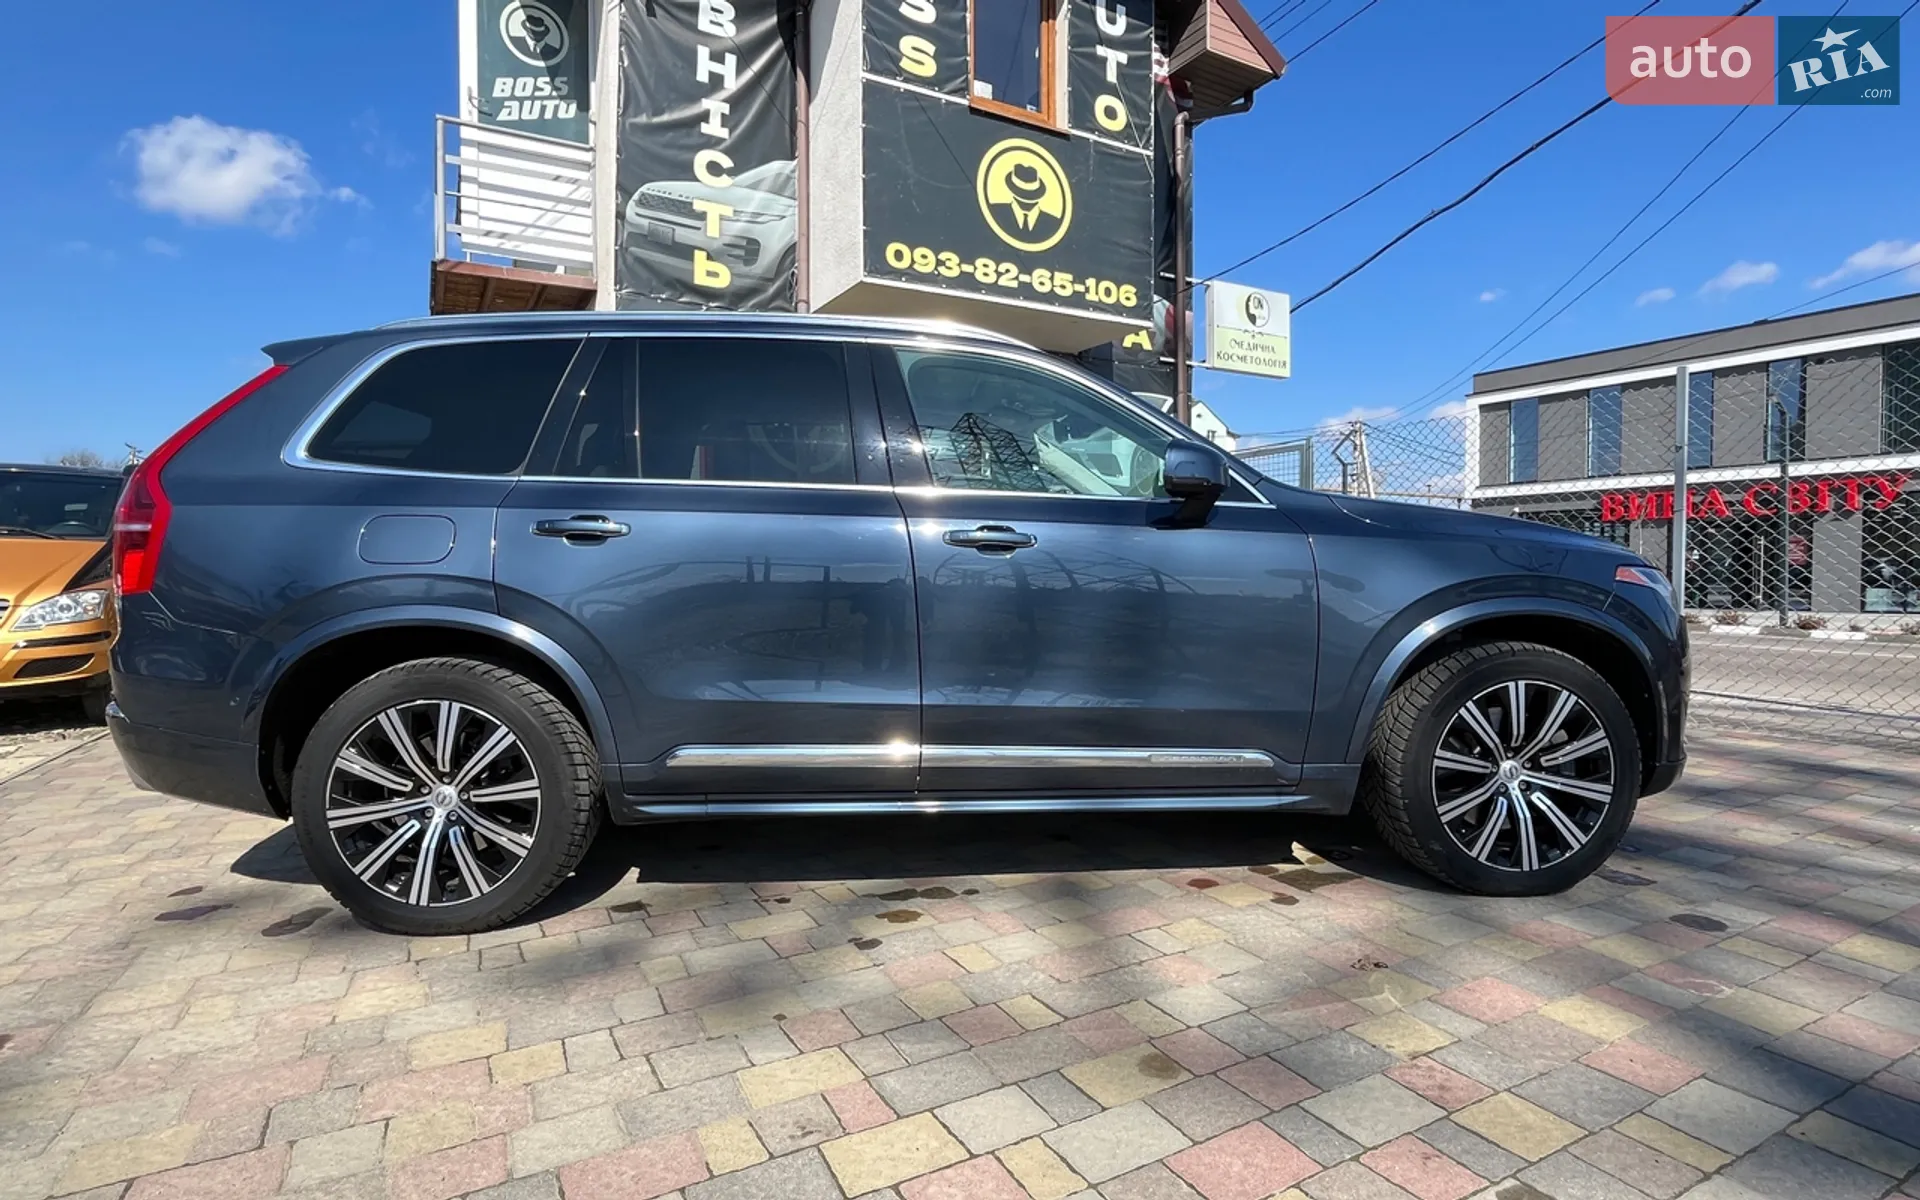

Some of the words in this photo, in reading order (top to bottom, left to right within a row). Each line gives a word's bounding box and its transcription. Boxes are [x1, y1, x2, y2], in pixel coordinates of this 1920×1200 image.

[492, 76, 569, 98] BOSS
[496, 99, 577, 121] AUTO
[885, 242, 1138, 308] 093-82-65-106
[1216, 350, 1287, 369] КОСМЕТОЛОГІЯ
